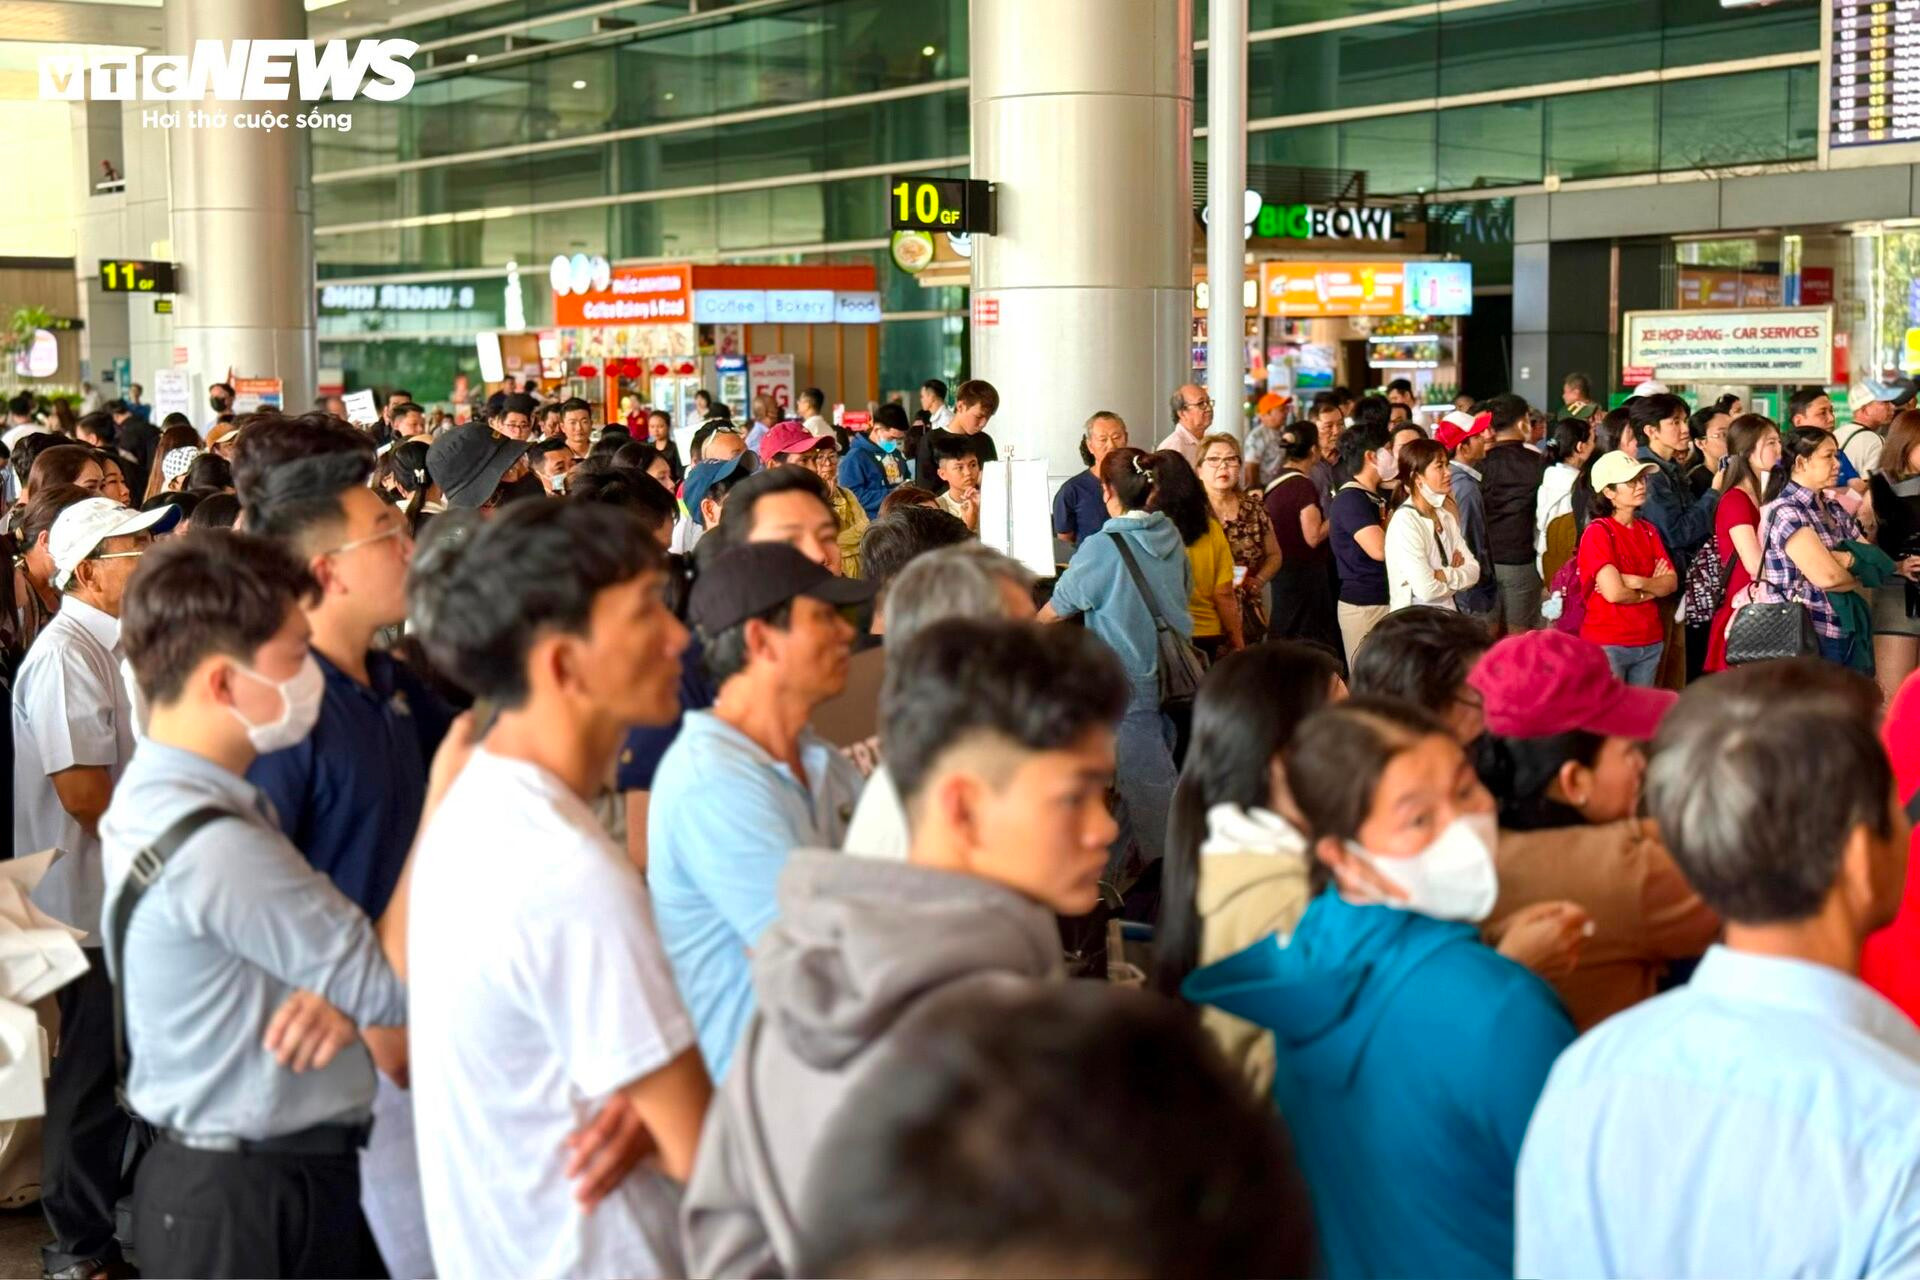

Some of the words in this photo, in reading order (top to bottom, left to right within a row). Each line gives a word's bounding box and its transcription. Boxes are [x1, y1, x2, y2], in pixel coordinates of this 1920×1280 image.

[893, 182, 939, 223] 10
[940, 210, 960, 224] GF
[103, 262, 135, 289] 11
[705, 299, 755, 313] Coffee
[841, 298, 876, 312] Food
[1732, 327, 1758, 340] CAR
[1760, 325, 1819, 339] SERVICES
